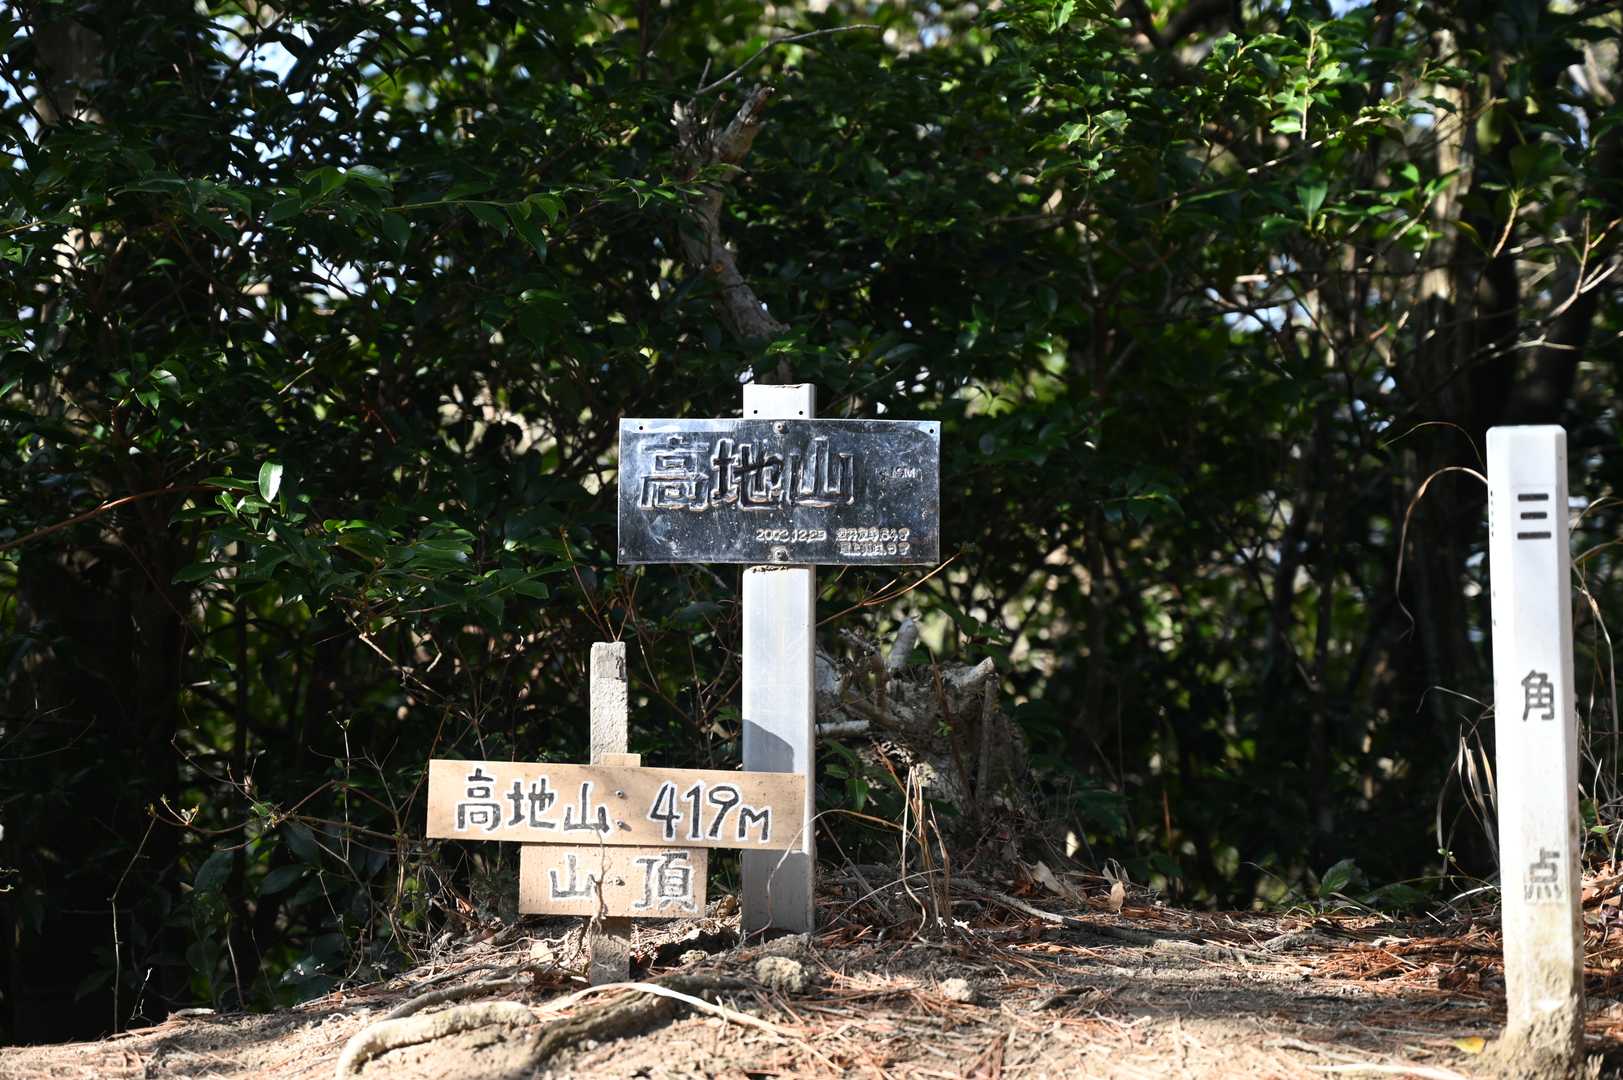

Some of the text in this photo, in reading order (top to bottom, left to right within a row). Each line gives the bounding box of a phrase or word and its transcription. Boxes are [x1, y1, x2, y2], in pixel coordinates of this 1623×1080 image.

[637, 434, 855, 512] 高地山
[1516, 492, 1563, 900] 三角点
[455, 766, 612, 836] 高地山
